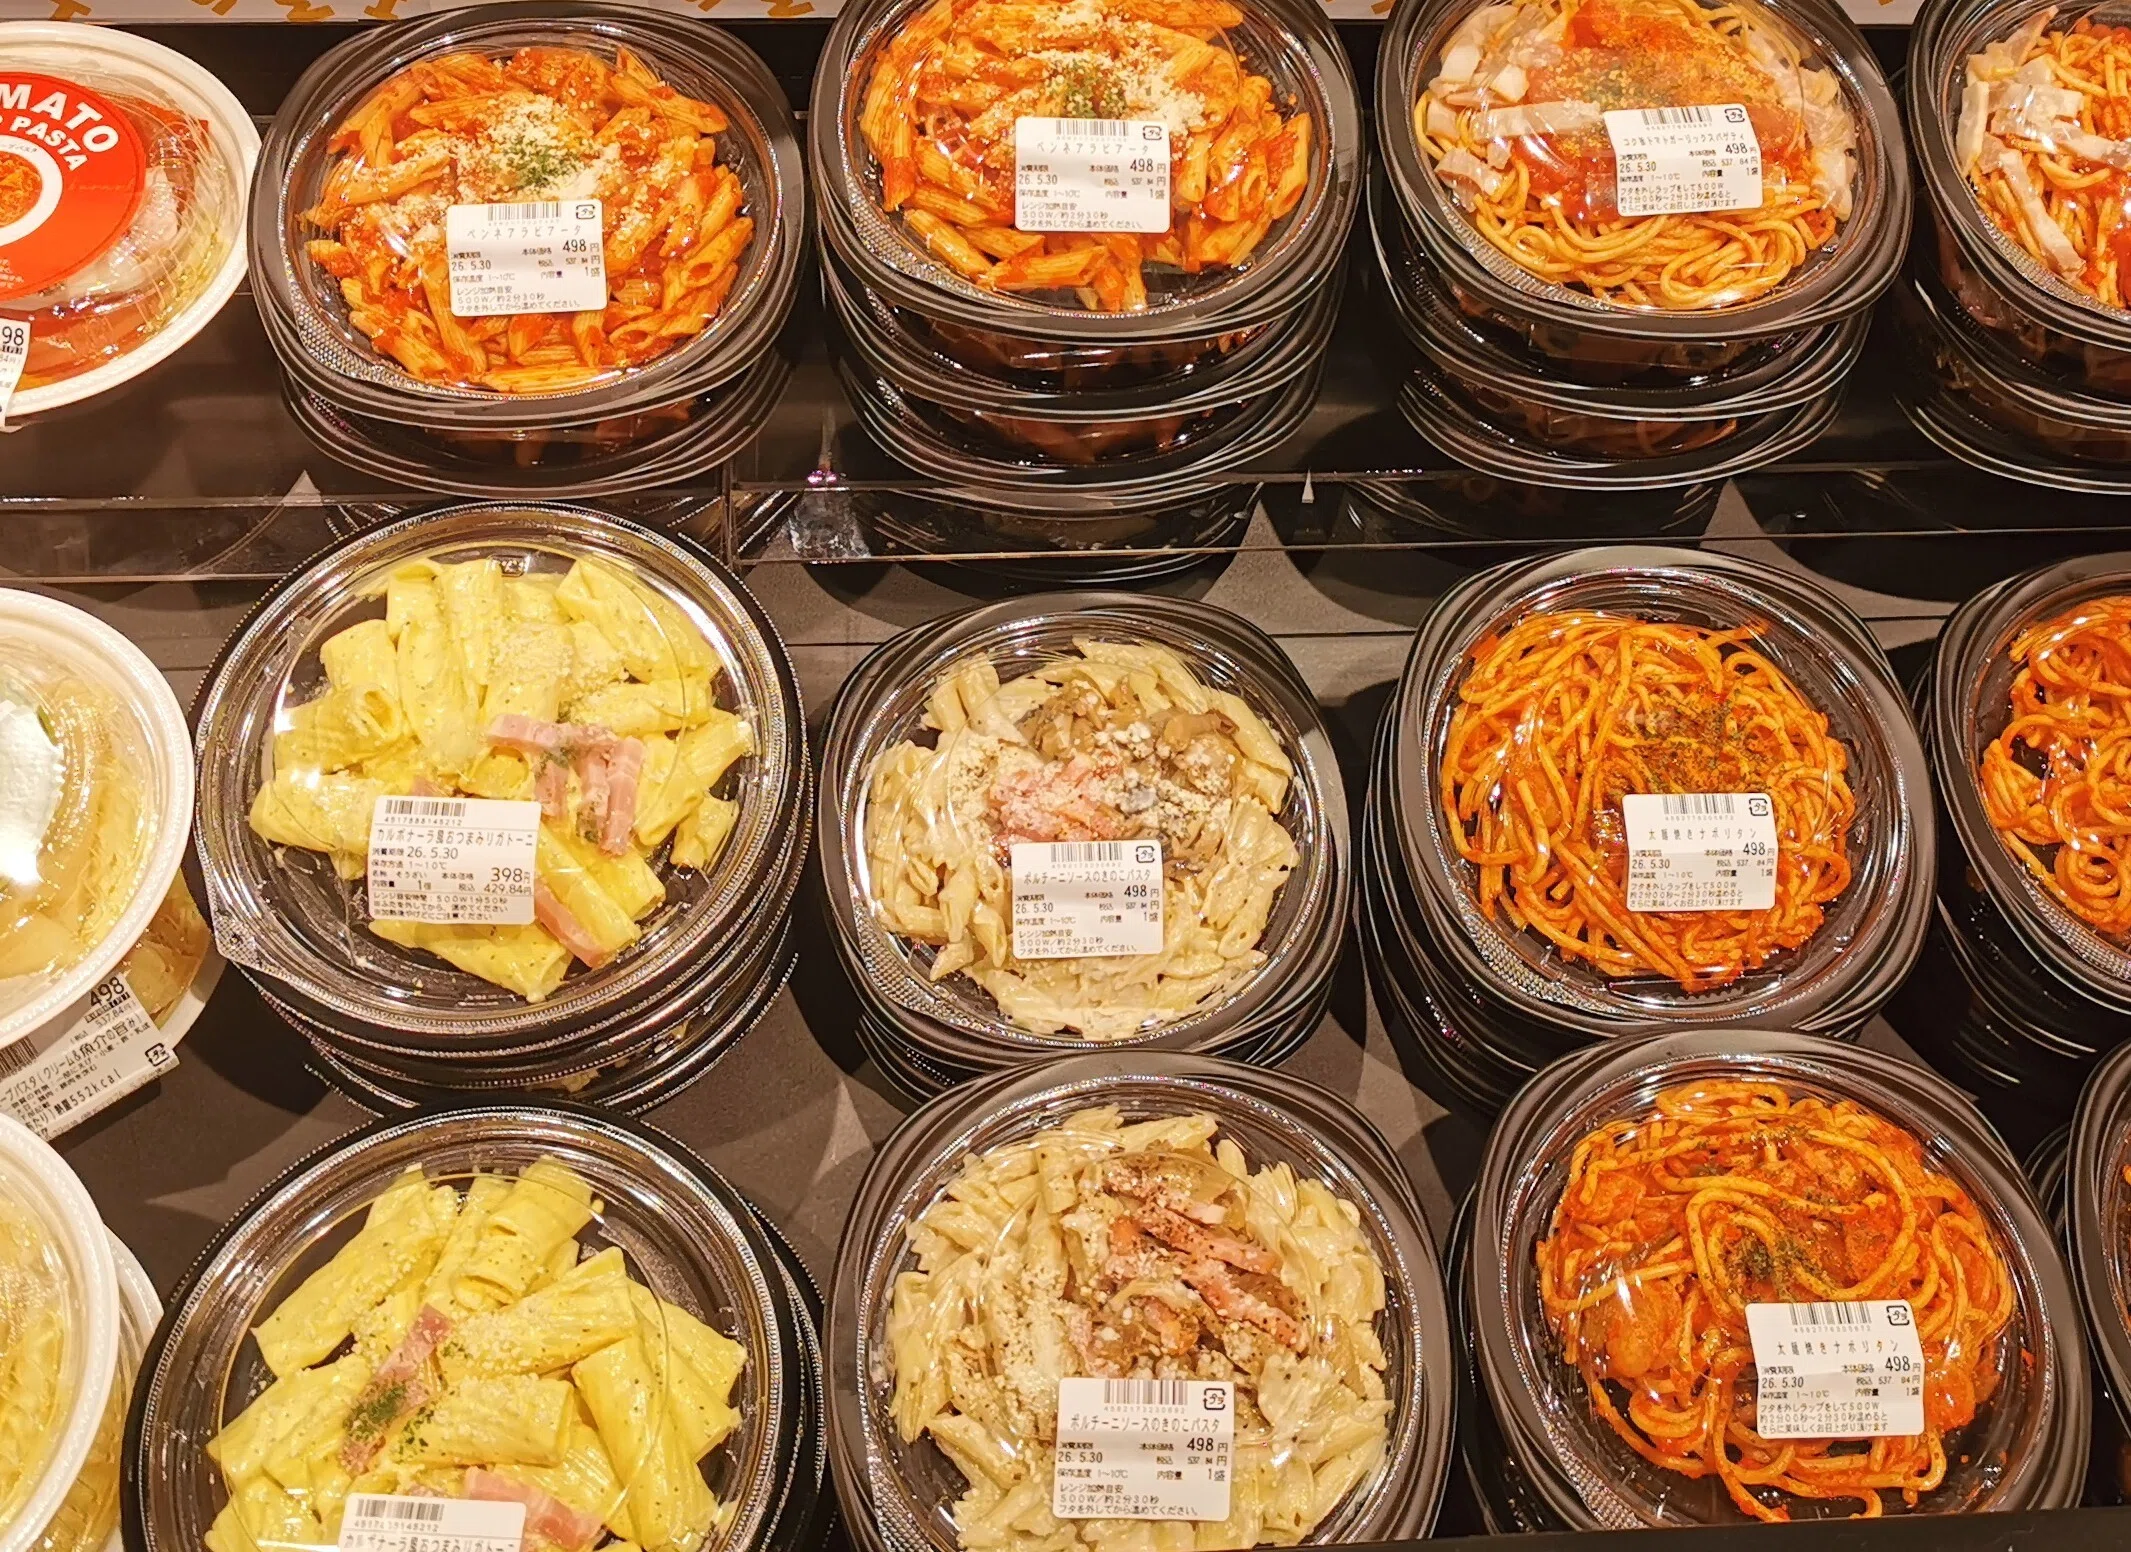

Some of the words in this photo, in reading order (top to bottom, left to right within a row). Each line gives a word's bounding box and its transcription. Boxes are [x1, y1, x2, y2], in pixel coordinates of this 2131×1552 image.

[9, 115, 88, 171] PASTA
[1071, 1414, 1220, 1433] ポルチーニソースのきのこパスタ
